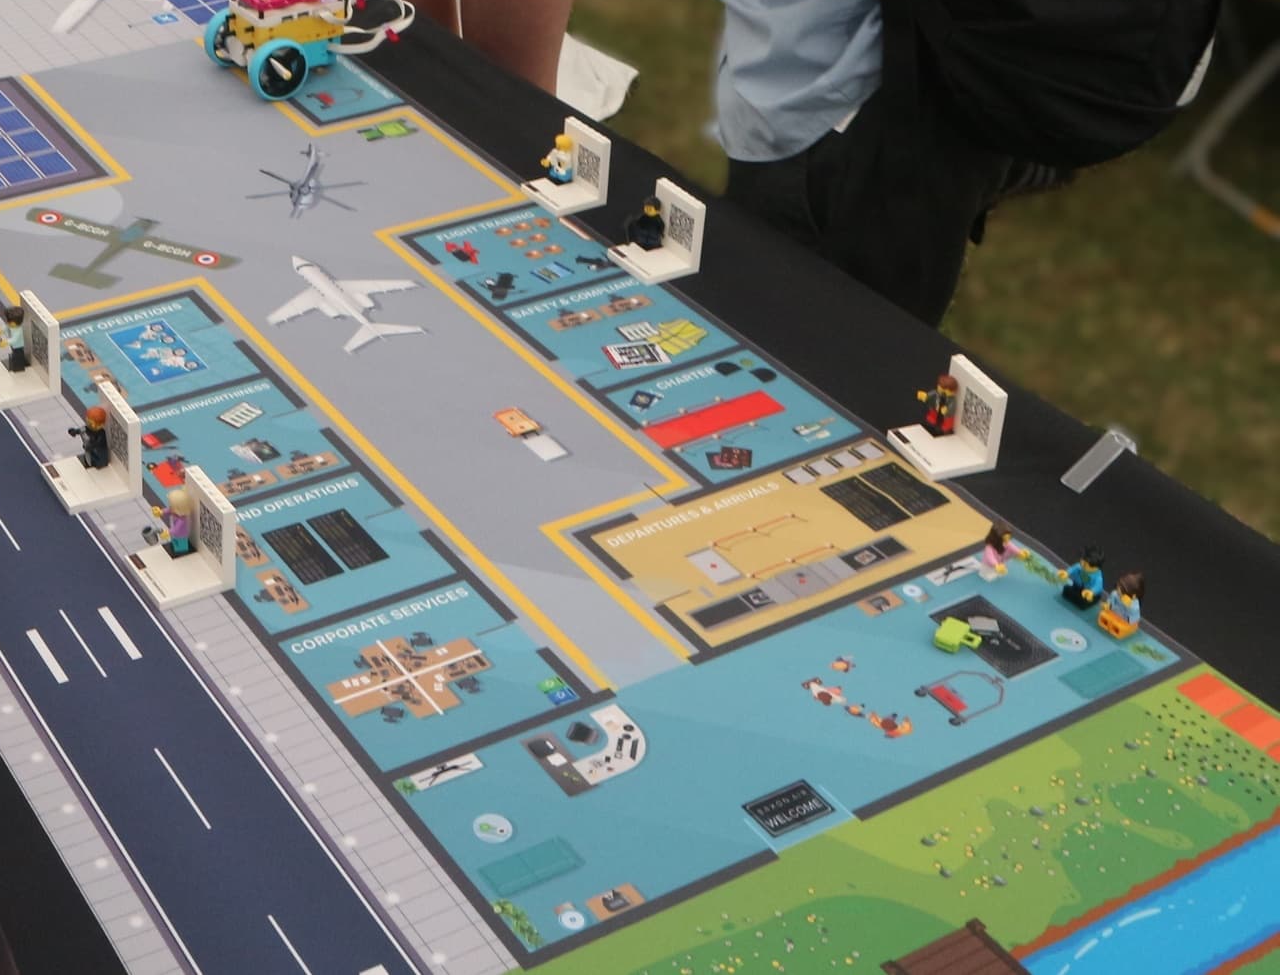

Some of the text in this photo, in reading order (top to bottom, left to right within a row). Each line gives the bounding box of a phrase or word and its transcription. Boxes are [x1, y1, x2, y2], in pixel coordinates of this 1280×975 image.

[97, 303, 182, 330] OPERATIONS
[656, 367, 718, 390] CHARTER
[181, 383, 271, 413] AIRWORTHINESS
[264, 478, 359, 513] OPERATIONS
[607, 509, 700, 548] DEPARTURES
[714, 482, 780, 510] ARRIVALS
[291, 587, 469, 654] CORPORATE SERVICES
[765, 797, 823, 828] WELCOME
